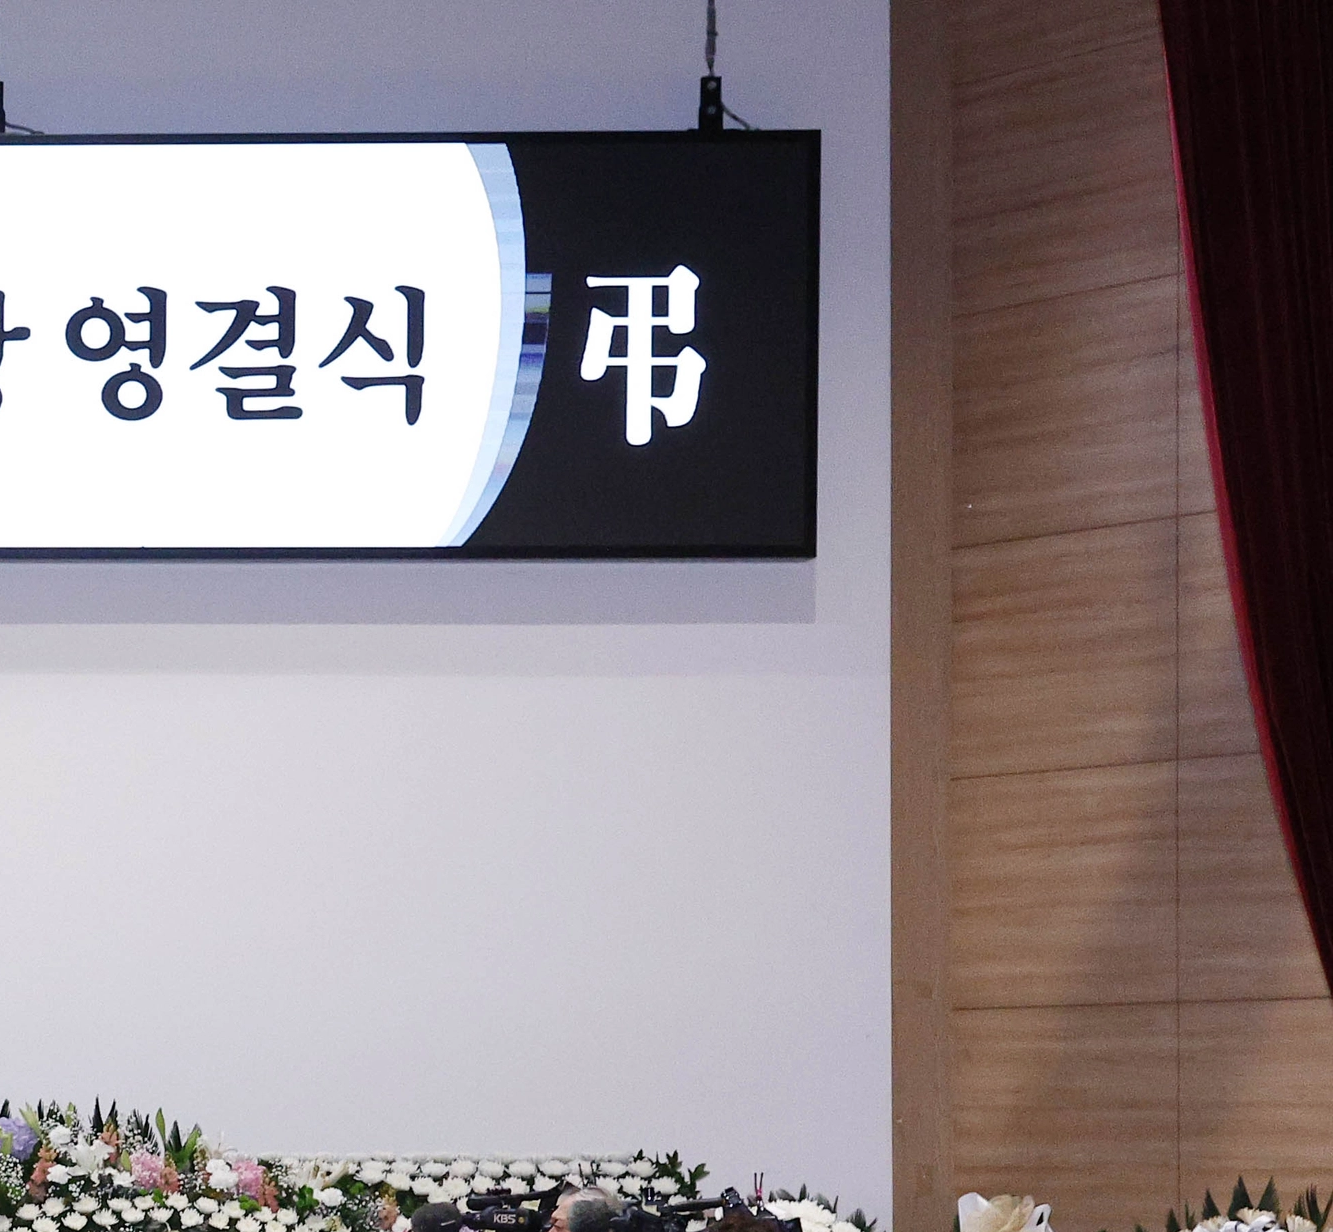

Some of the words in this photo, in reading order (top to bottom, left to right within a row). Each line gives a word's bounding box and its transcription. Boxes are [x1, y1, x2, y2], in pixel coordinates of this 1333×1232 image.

[66, 286, 426, 425] 영결식
[580, 265, 707, 445] 弔
[493, 1213, 516, 1224] KBS
